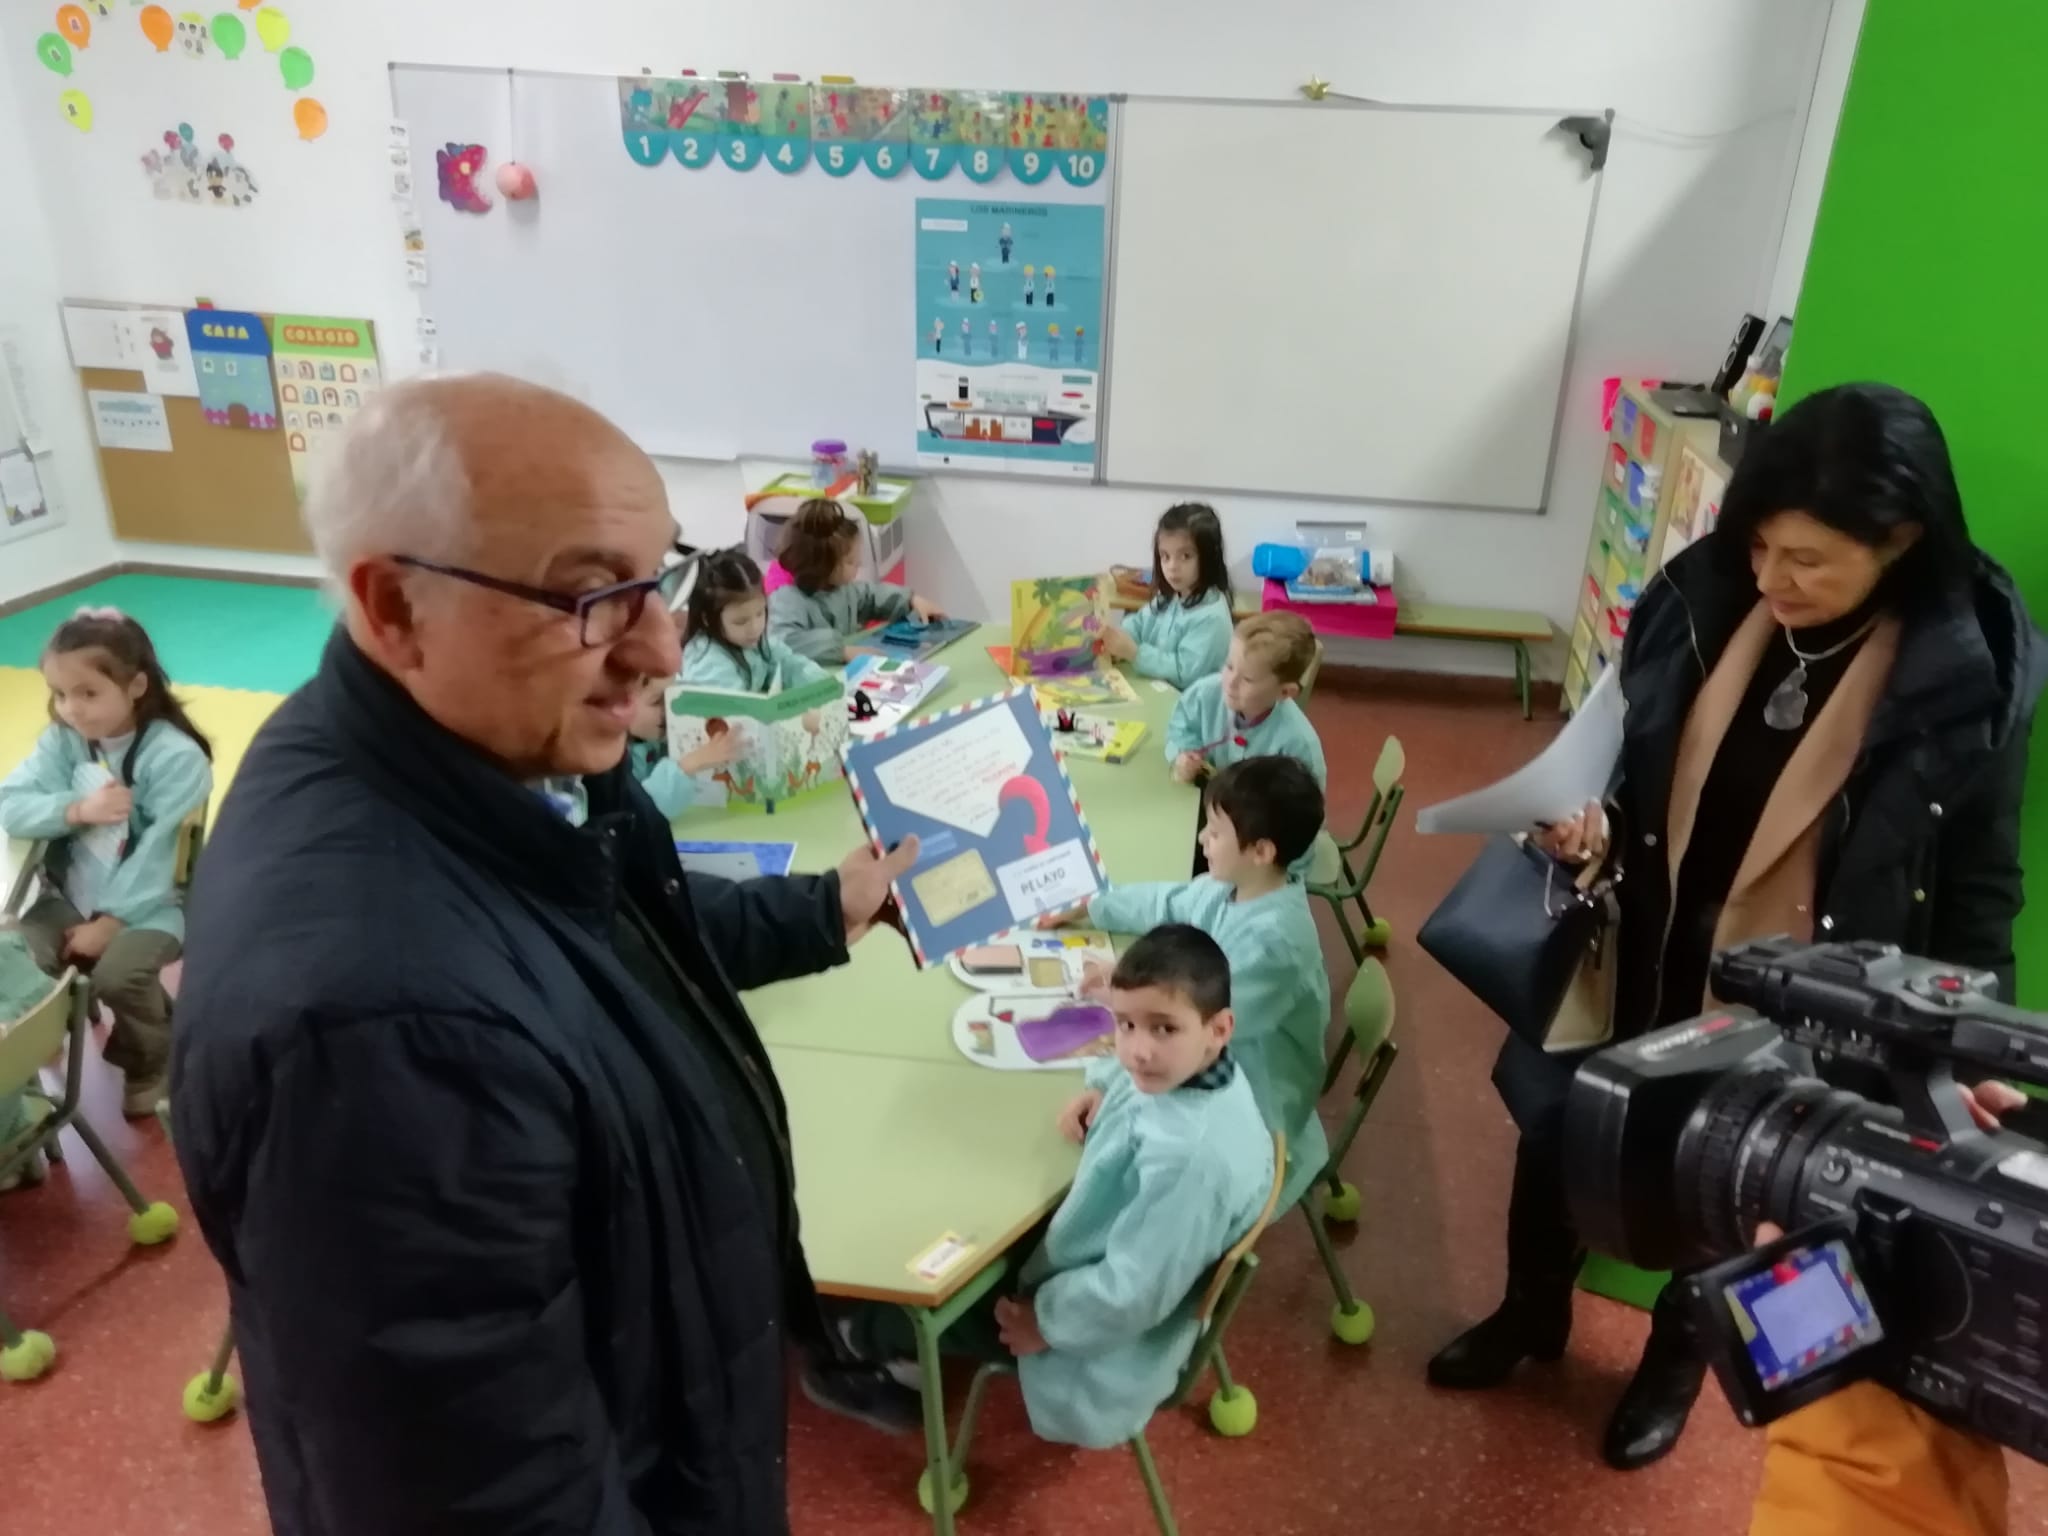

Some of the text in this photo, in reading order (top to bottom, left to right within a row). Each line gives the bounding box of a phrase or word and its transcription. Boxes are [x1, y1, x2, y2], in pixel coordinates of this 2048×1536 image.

[639, 135, 1095, 179] 1 2 3 4 5 6 7 8 9 10
[202, 323, 249, 340] CASA
[284, 326, 357, 344] COLEGIO
[1020, 867, 1066, 896] PELAYO
